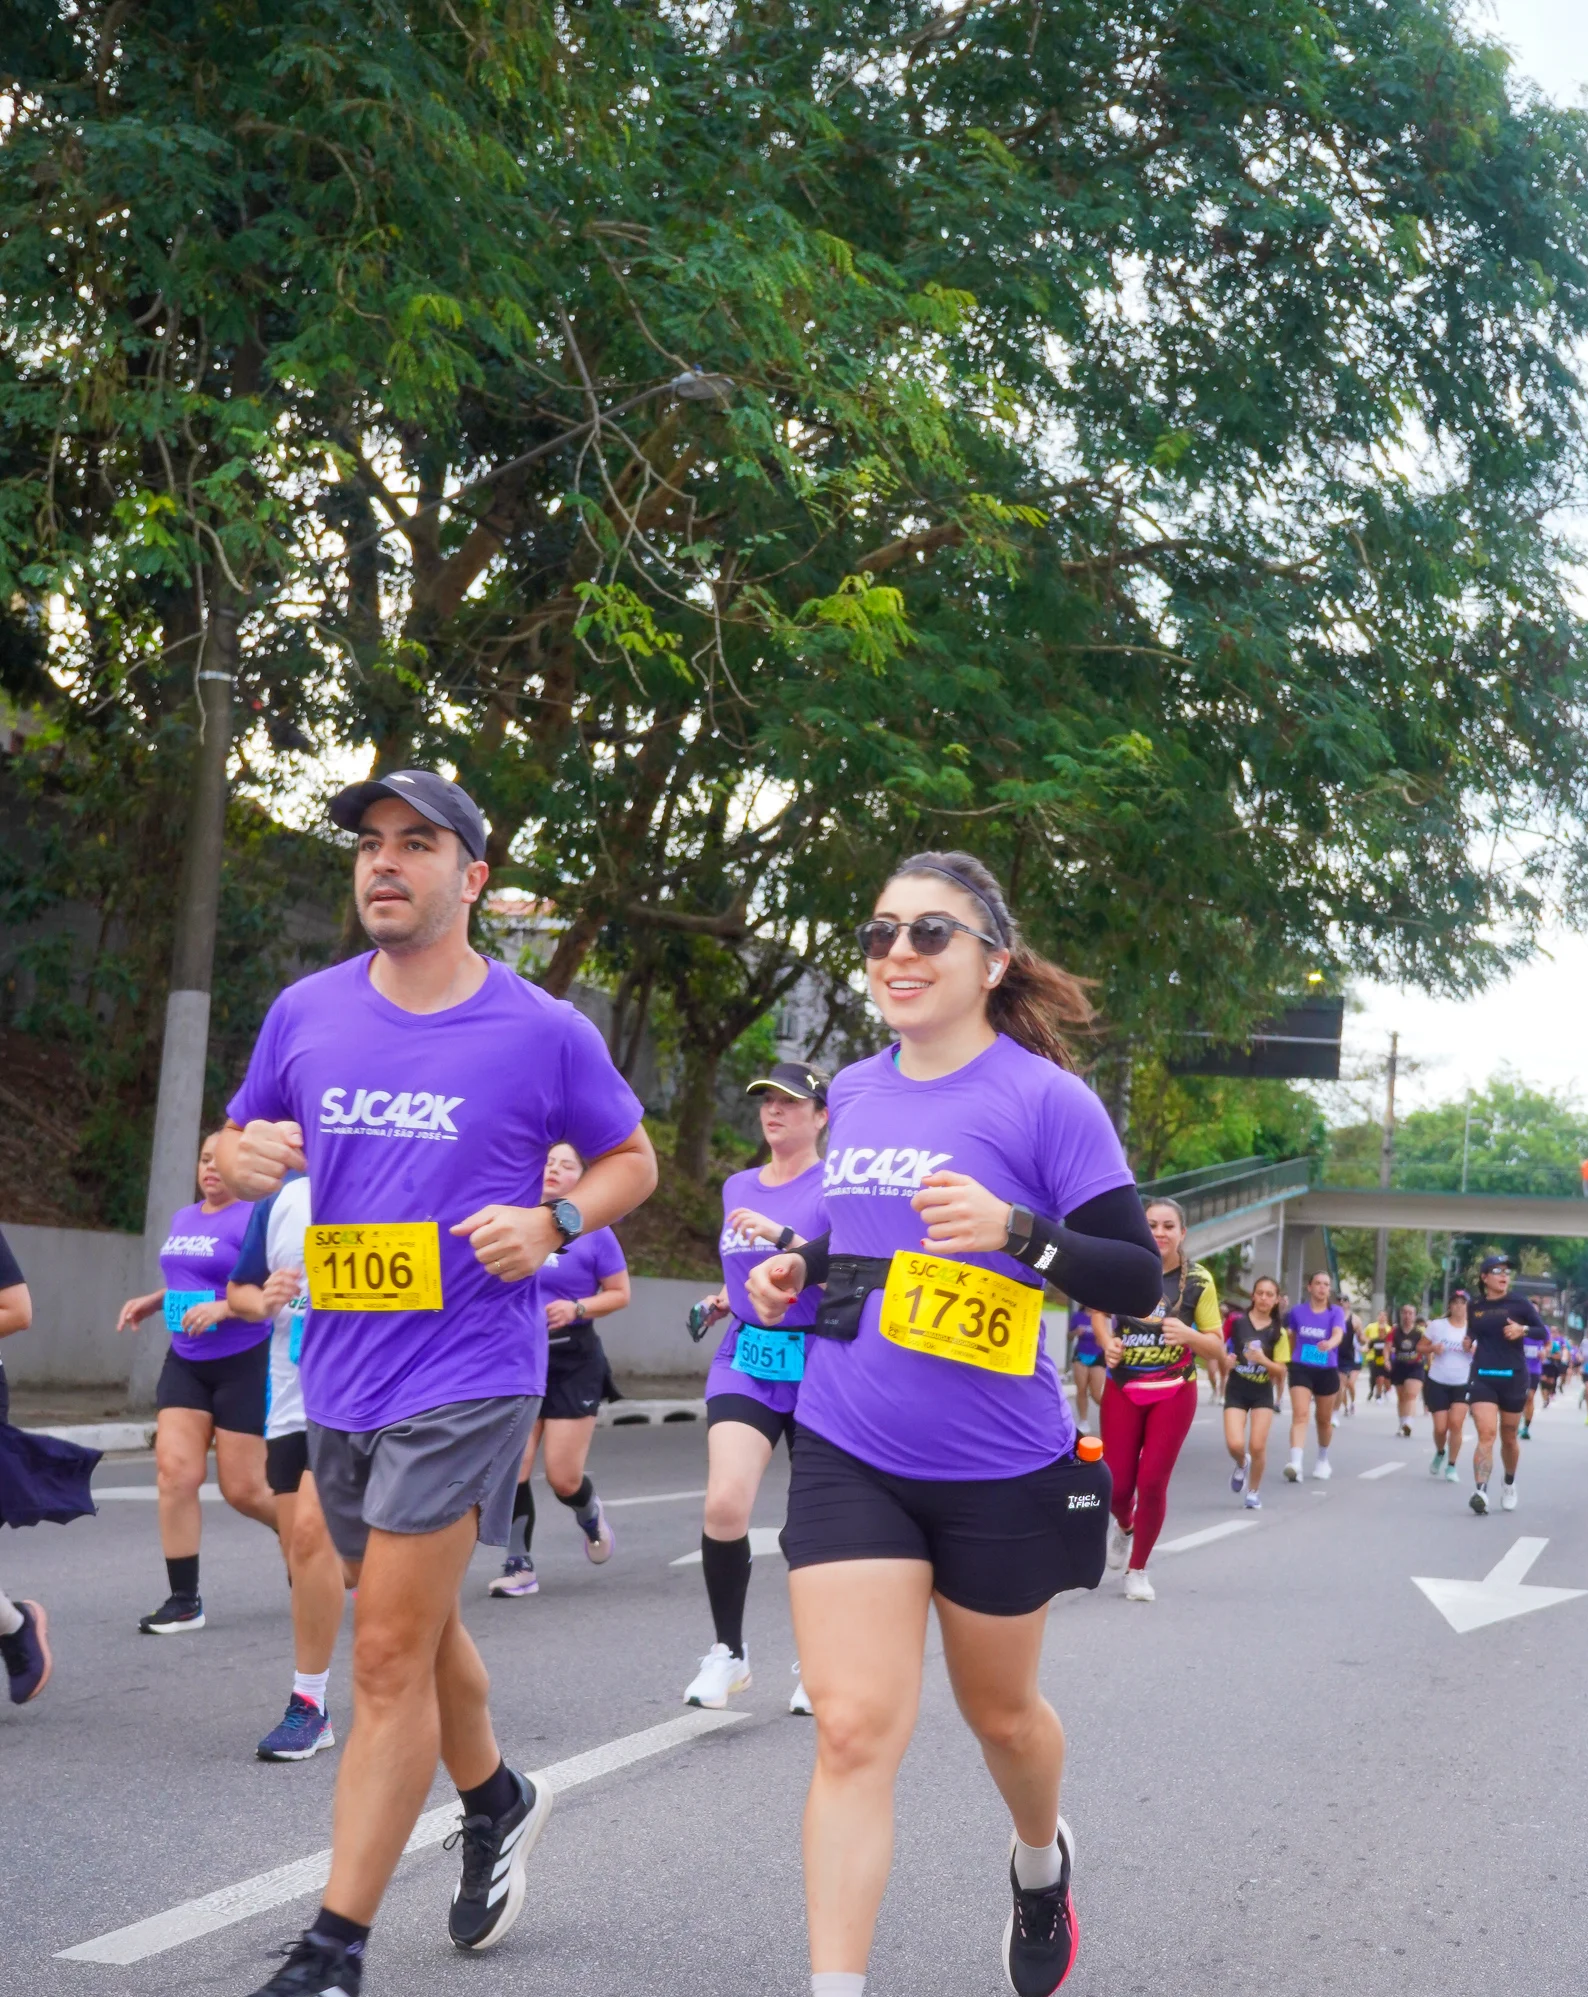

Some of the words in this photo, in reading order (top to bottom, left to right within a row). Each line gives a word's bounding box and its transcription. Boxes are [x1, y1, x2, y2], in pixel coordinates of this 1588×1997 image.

[320, 1087, 466, 1132] SJC42K
[822, 1147, 954, 1189] SJC42K
[323, 1251, 413, 1290] 1106
[908, 1259, 972, 1287] SJC42K
[904, 1284, 1012, 1348] 1736
[742, 1341, 787, 1369] 5051
